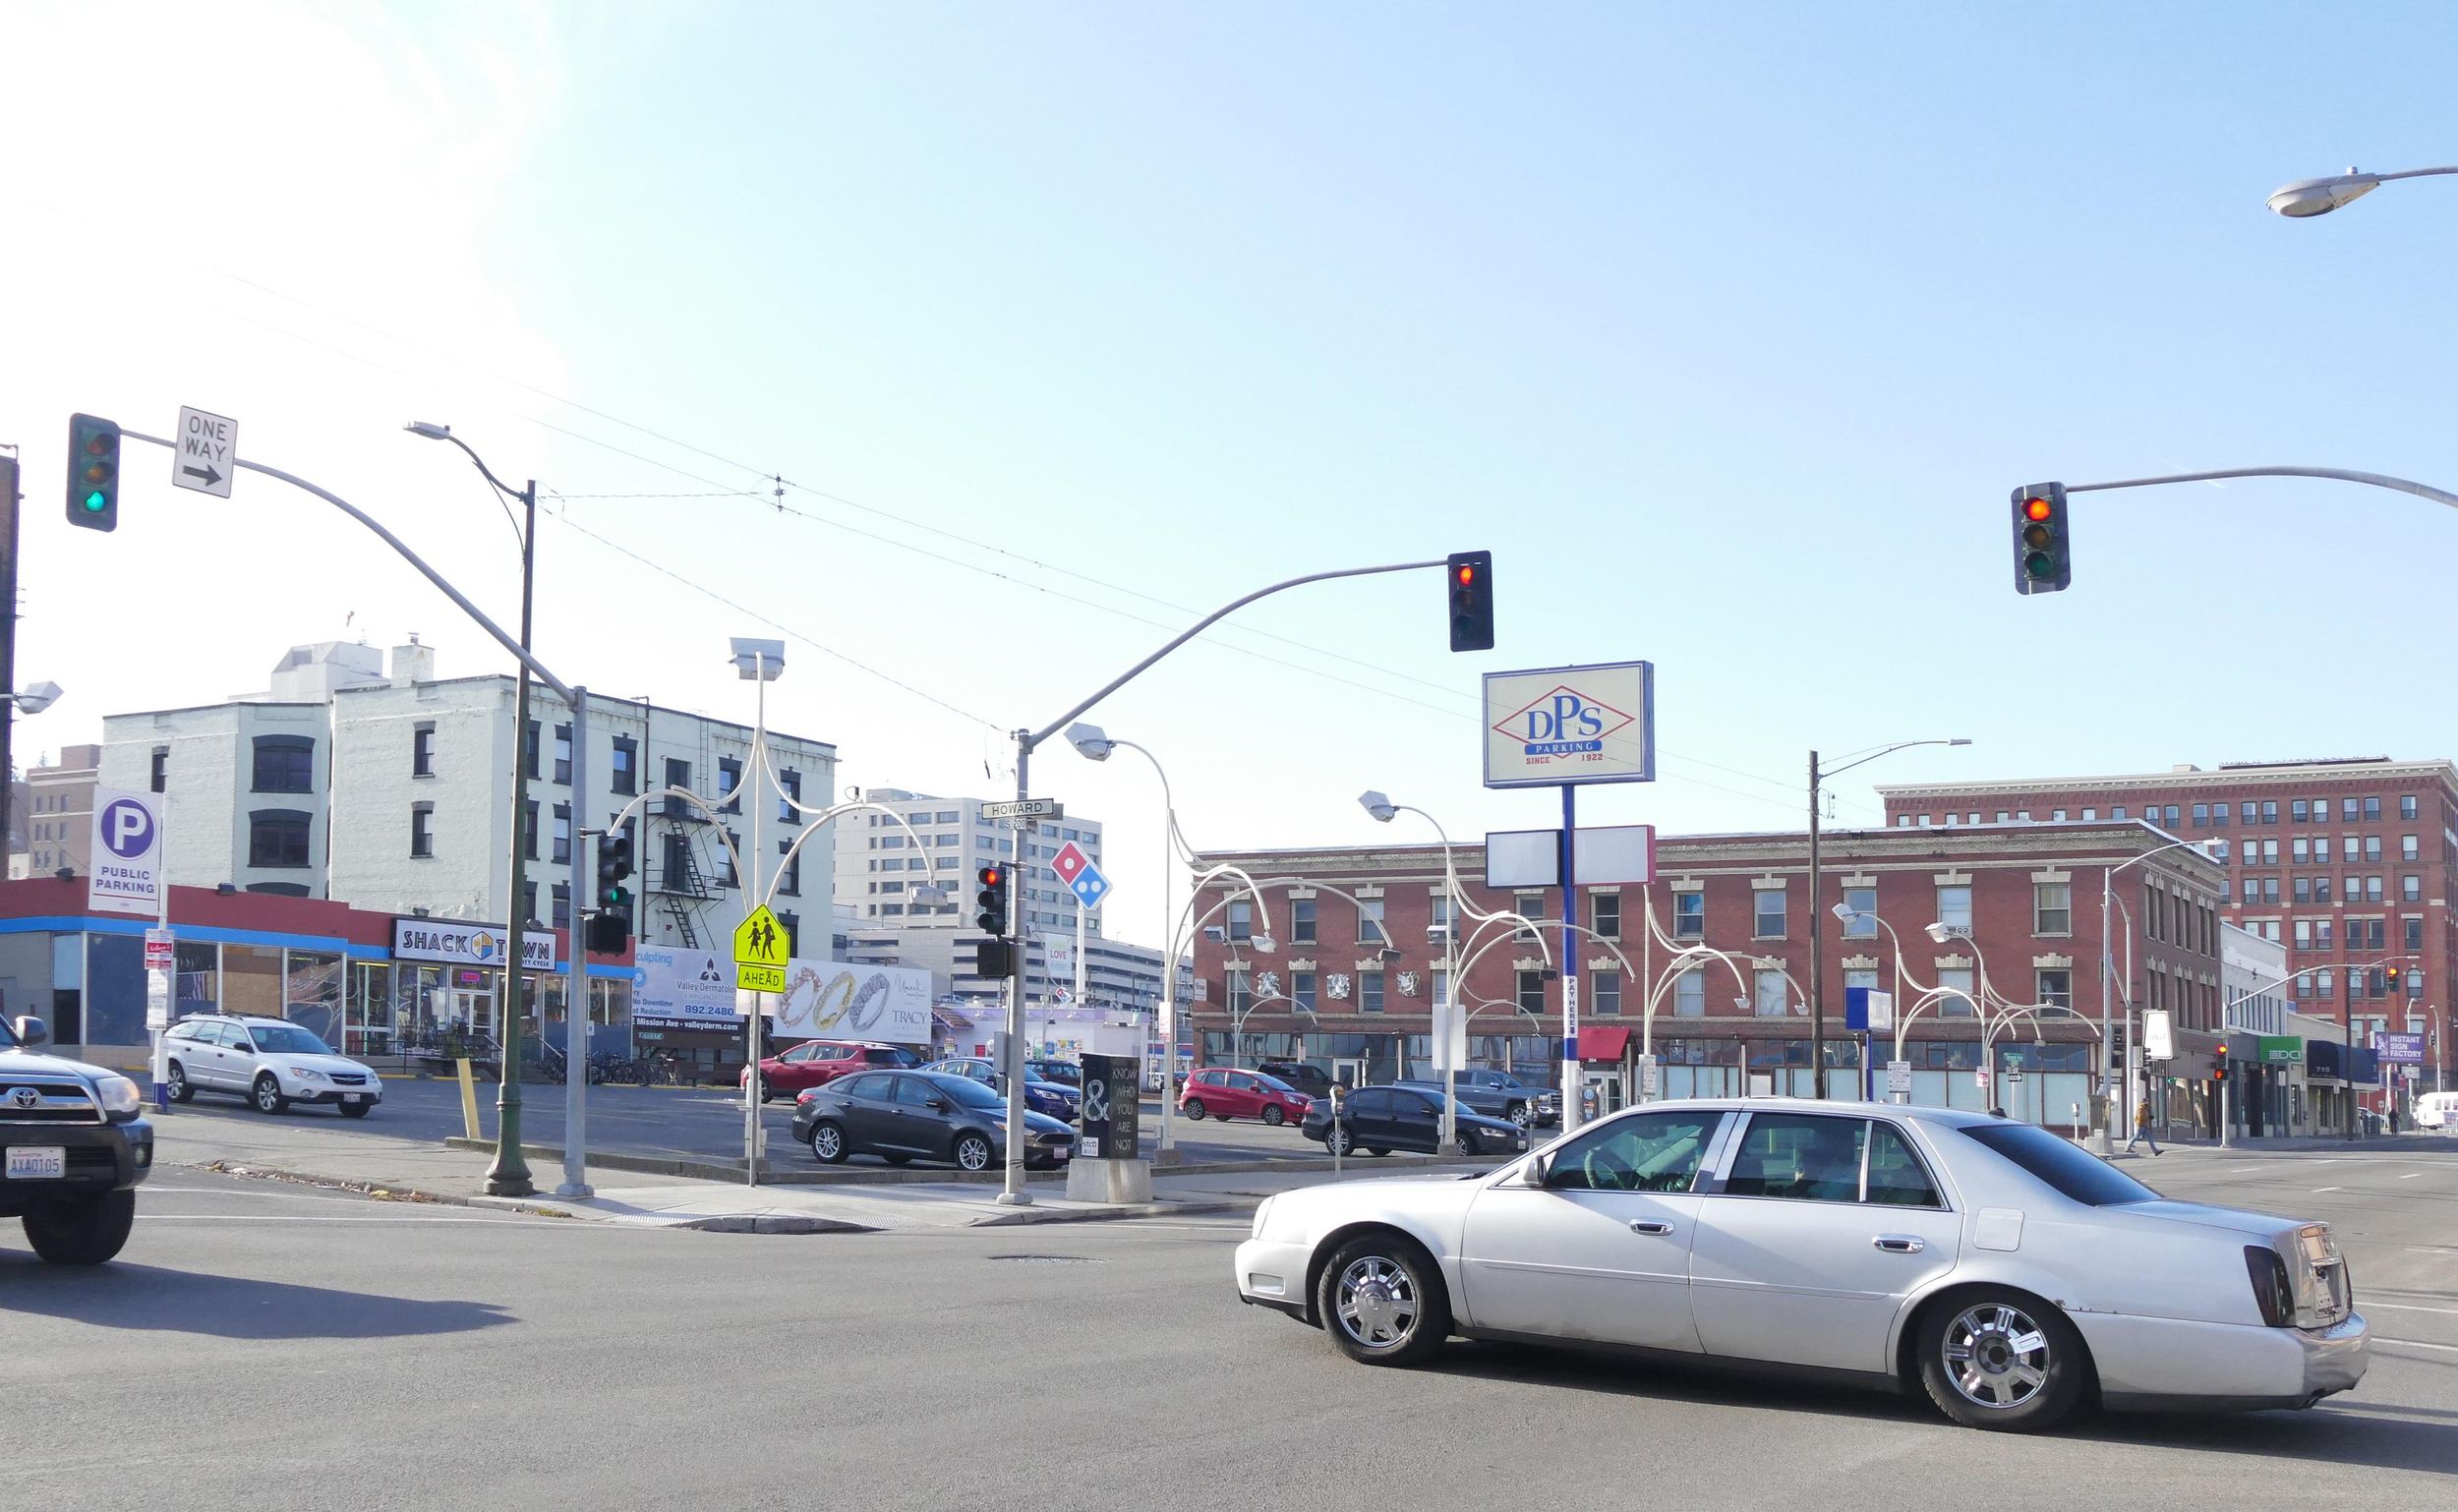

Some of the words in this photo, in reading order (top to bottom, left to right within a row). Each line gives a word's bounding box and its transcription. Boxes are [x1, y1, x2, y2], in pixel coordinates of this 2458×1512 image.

[189, 415, 227, 442] ONE
[185, 436, 226, 462] WAY
[1526, 694, 1603, 740] DPS
[1536, 743, 1594, 754] PARKING
[1526, 756, 1551, 765] SINCE
[1581, 753, 1604, 762] 1922
[991, 802, 1043, 816] HOWARD
[114, 805, 146, 850] P
[1005, 820, 1011, 829] S
[1014, 819, 1025, 829] 200
[101, 866, 150, 881] PUBLIC
[95, 879, 154, 894] PARKING
[403, 930, 468, 954] SHACK
[496, 938, 550, 960] TWN
[1050, 950, 1067, 960] LOVE
[743, 971, 780, 987] AHEAD
[676, 981, 698, 992] Valley
[684, 1005, 734, 1017] 892.2480
[892, 1010, 927, 1023] TRACY
[636, 1018, 665, 1026] Mission
[684, 1021, 738, 1031] valleyderm.com
[1112, 1068, 1139, 1079] KNOW
[1116, 1086, 1136, 1098] WHO
[1116, 1104, 1134, 1116] YOU
[1116, 1122, 1132, 1133] ARE
[1115, 1139, 1132, 1151] NOT
